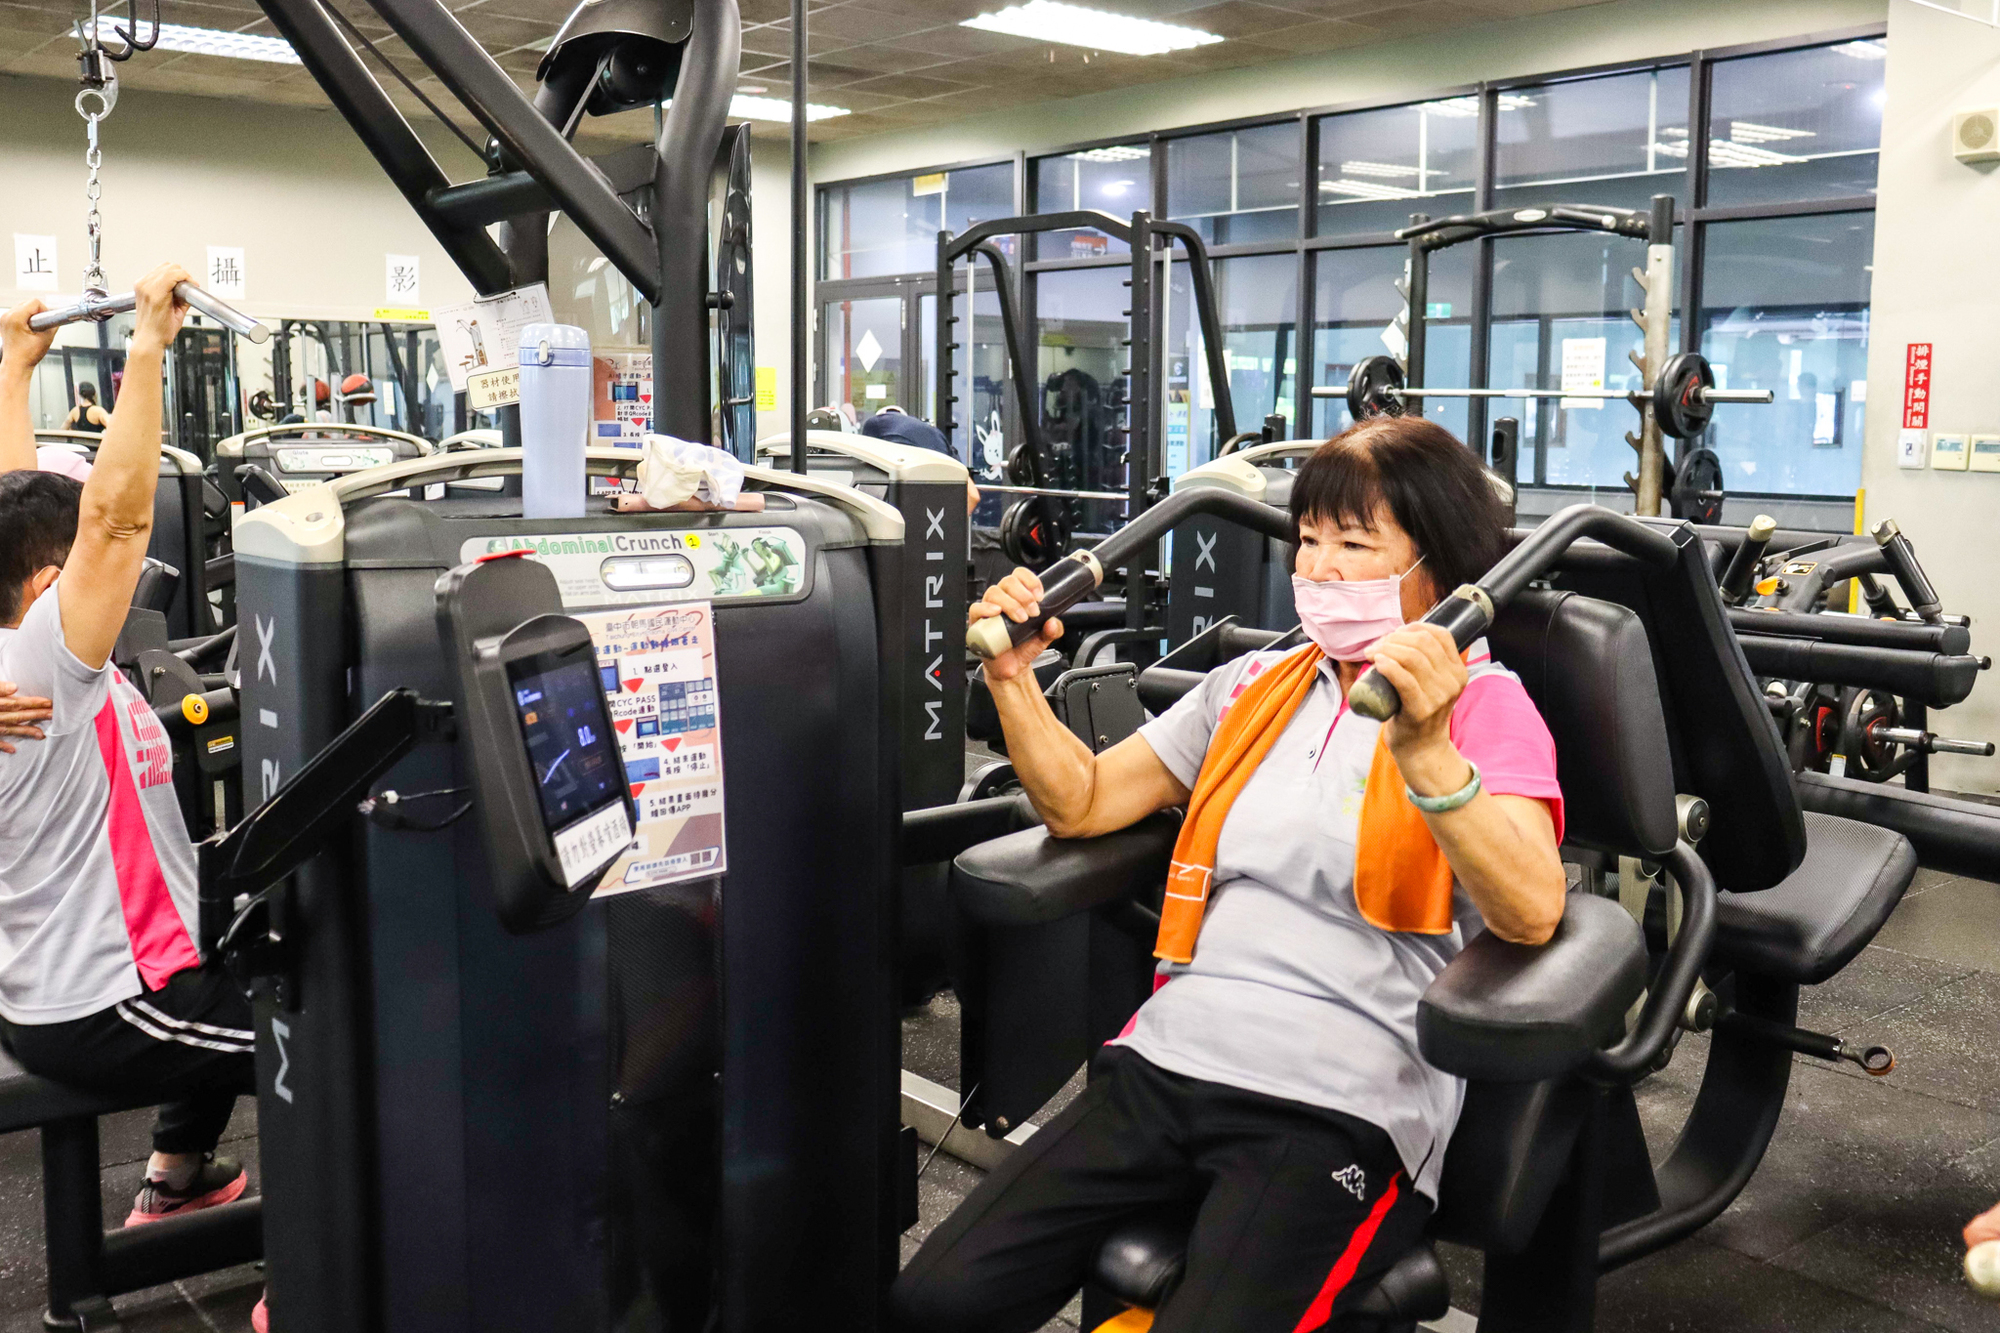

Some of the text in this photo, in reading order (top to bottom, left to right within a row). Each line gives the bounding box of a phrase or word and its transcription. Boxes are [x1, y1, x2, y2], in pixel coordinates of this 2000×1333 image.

[22, 248, 416, 292] 止 攝 影
[615, 534, 683, 551] Crunch
[924, 507, 944, 740] MATRIX
[636, 695, 656, 704] PASS
[612, 704, 655, 717] Rcode運動
